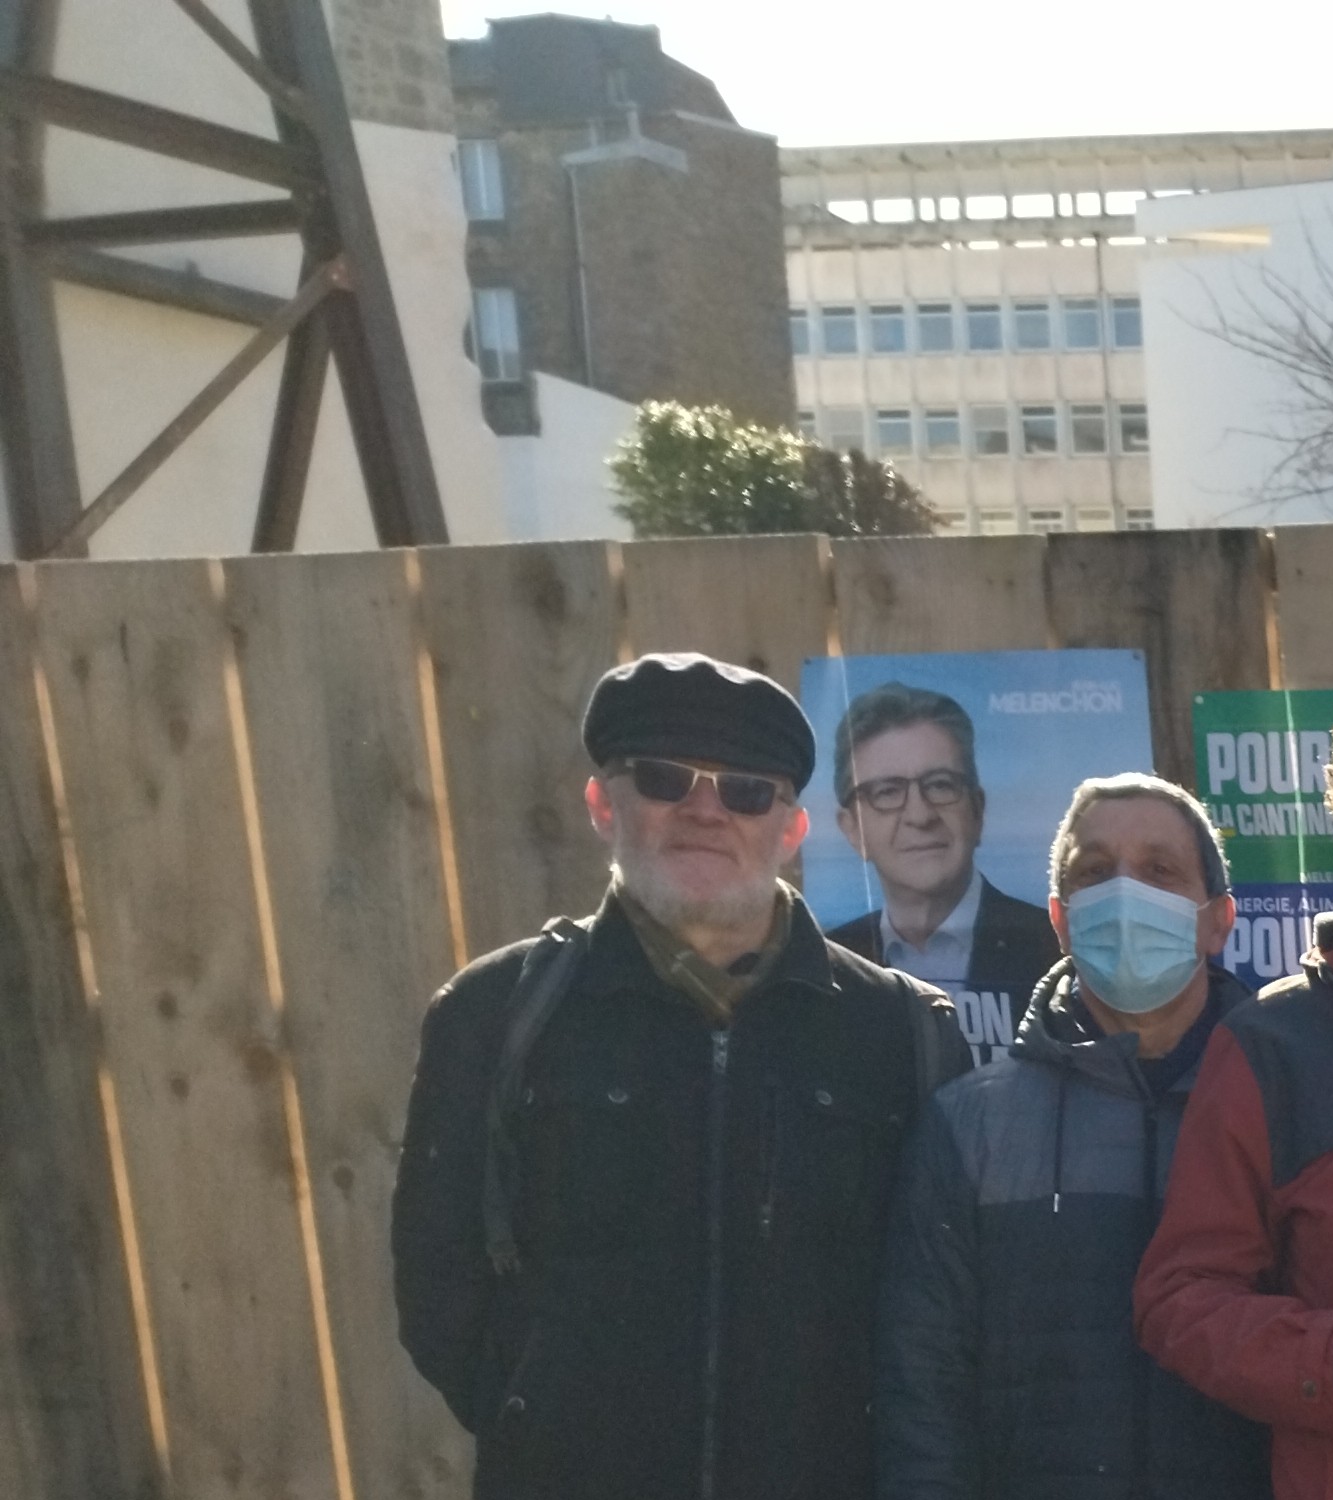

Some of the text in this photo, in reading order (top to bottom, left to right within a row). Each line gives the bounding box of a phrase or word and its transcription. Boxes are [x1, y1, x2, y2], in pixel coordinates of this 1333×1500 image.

[1206, 731, 1332, 796] POUR
[1234, 896, 1295, 915] NERGIE,
[1223, 916, 1311, 977] POU
